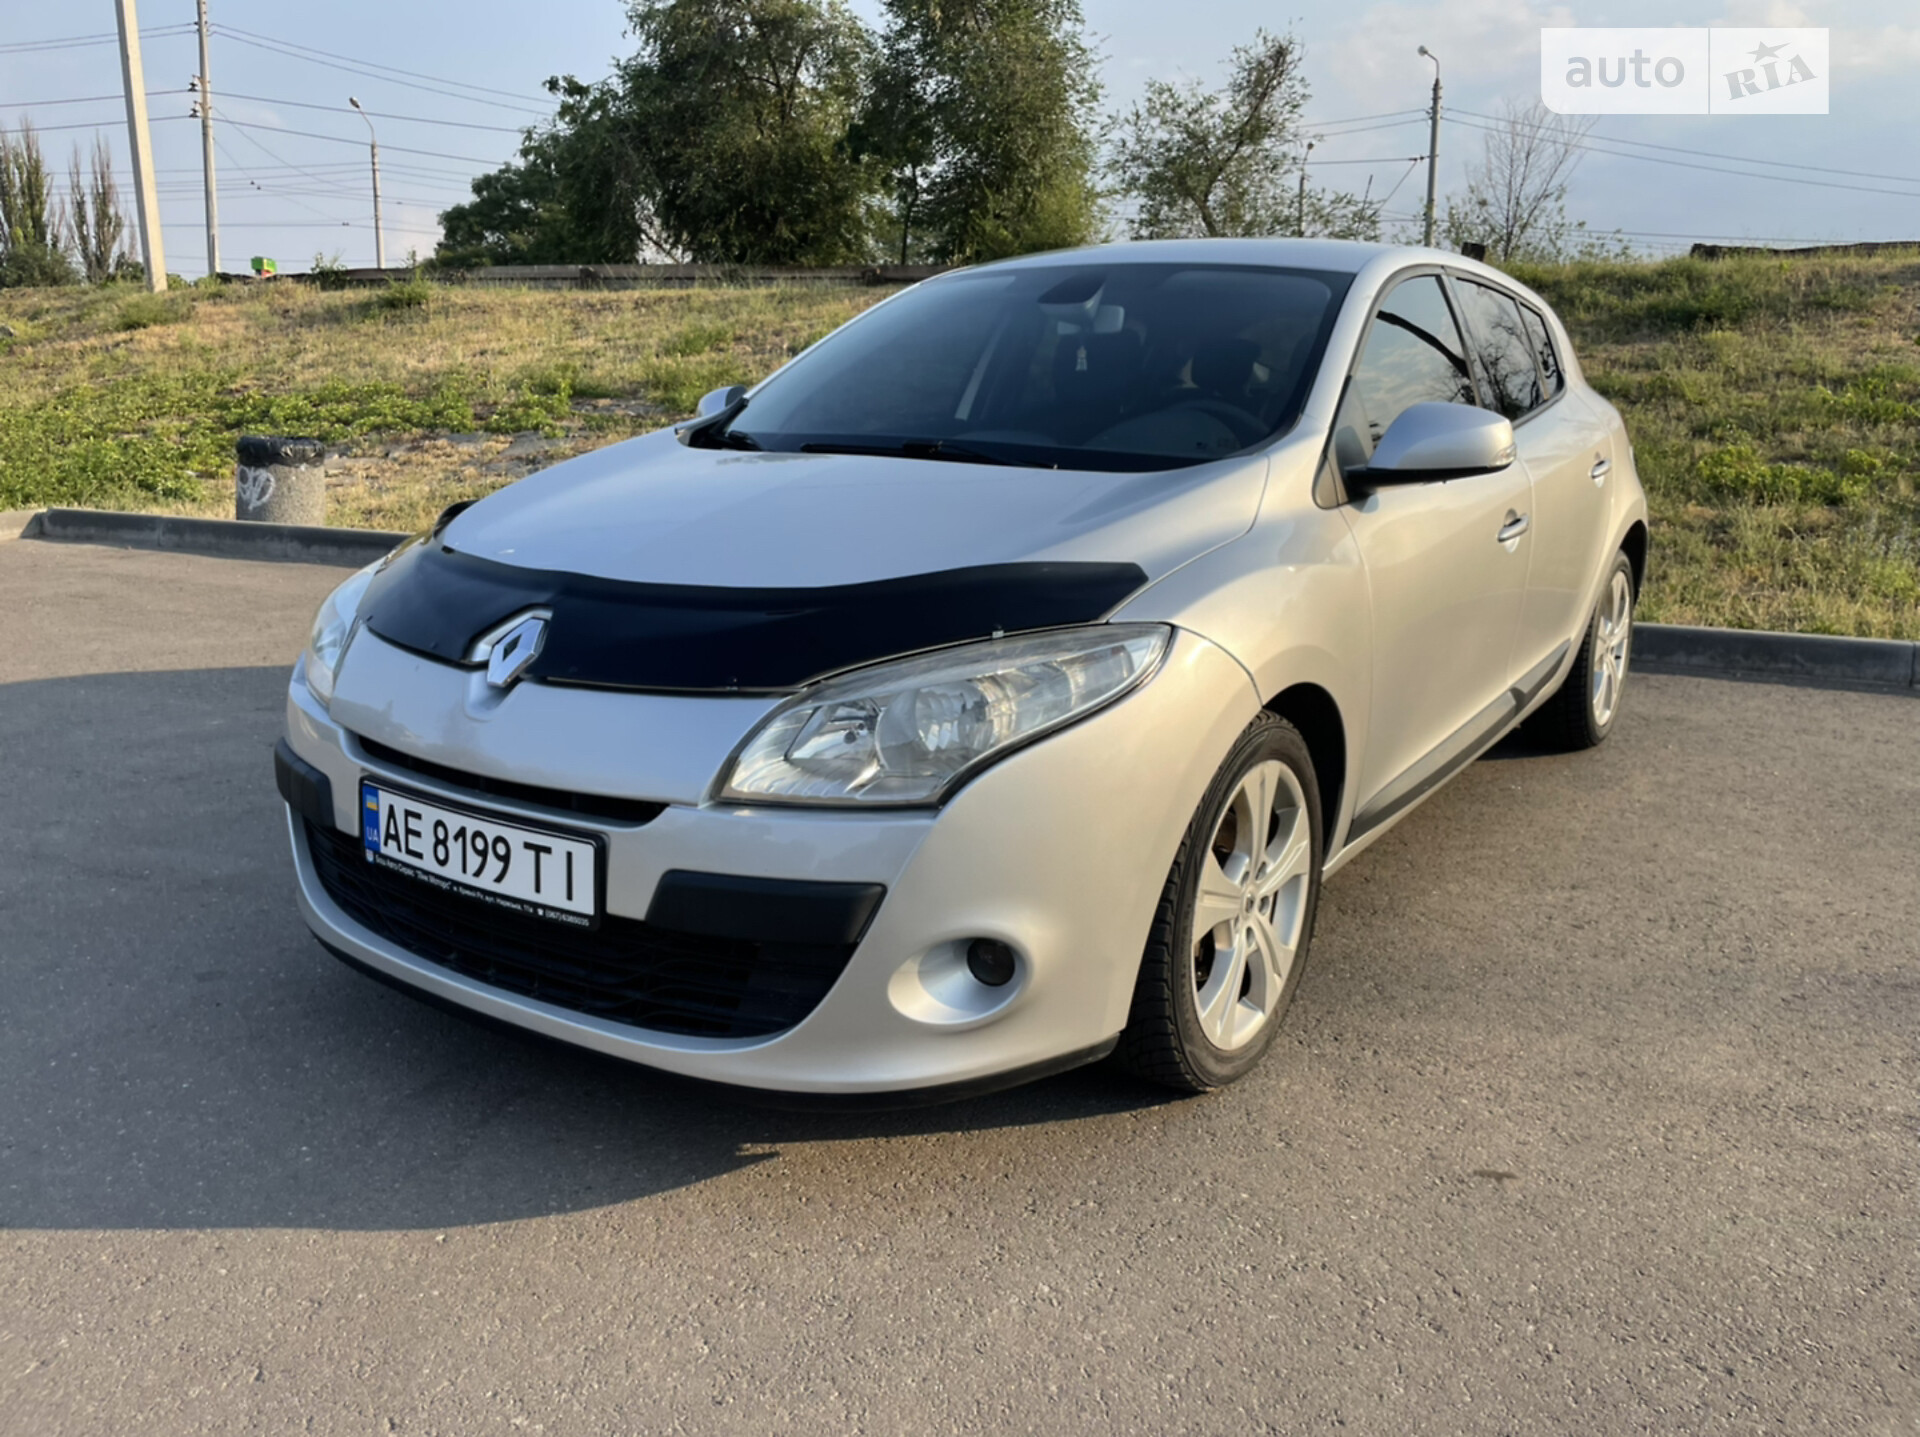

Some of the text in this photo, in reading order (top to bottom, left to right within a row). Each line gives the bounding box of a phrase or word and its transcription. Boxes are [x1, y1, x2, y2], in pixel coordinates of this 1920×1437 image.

[366, 826, 380, 843] UA
[383, 803, 424, 861] AE
[432, 818, 512, 884] 8199
[523, 840, 574, 902] TI
